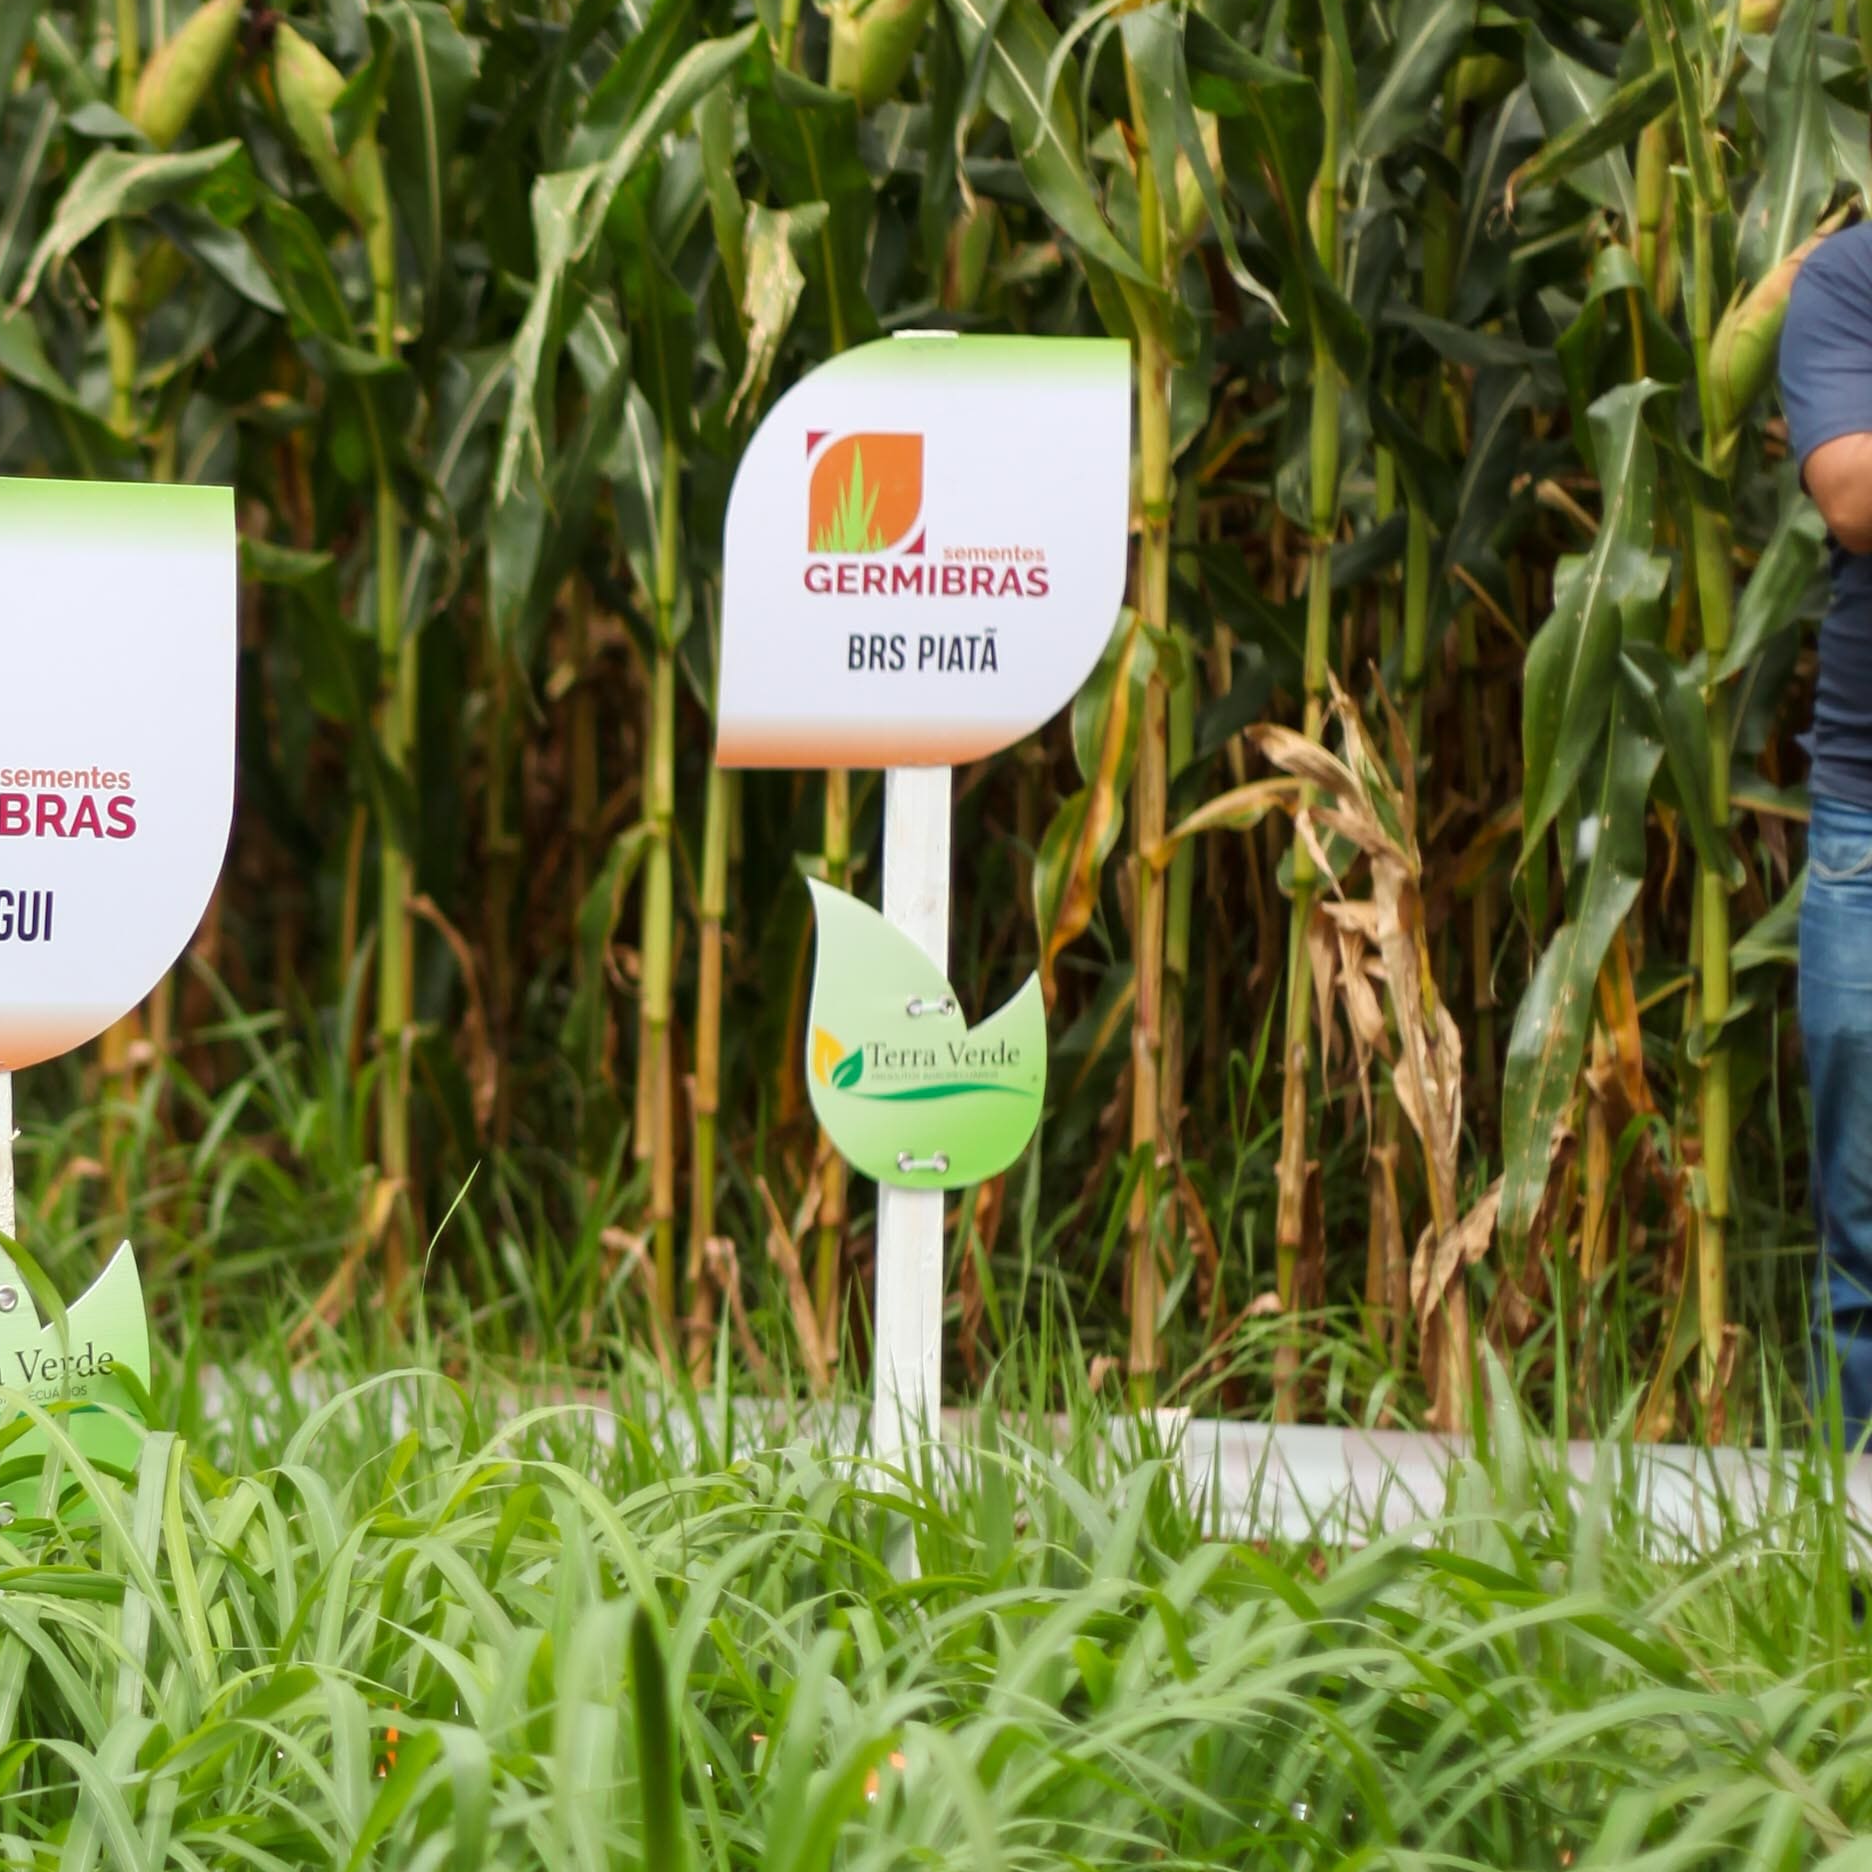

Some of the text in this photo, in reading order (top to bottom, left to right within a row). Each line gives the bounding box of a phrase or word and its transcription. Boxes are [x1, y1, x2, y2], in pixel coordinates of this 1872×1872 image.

[943, 544, 1045, 562] sementes
[803, 563, 1050, 597] GERMIBRAS
[847, 628, 998, 672] BRS PIATÃ
[0, 766, 131, 790] sementes
[866, 1038, 1021, 1067] Terra Verde
[14, 1341, 115, 1384] Verde
